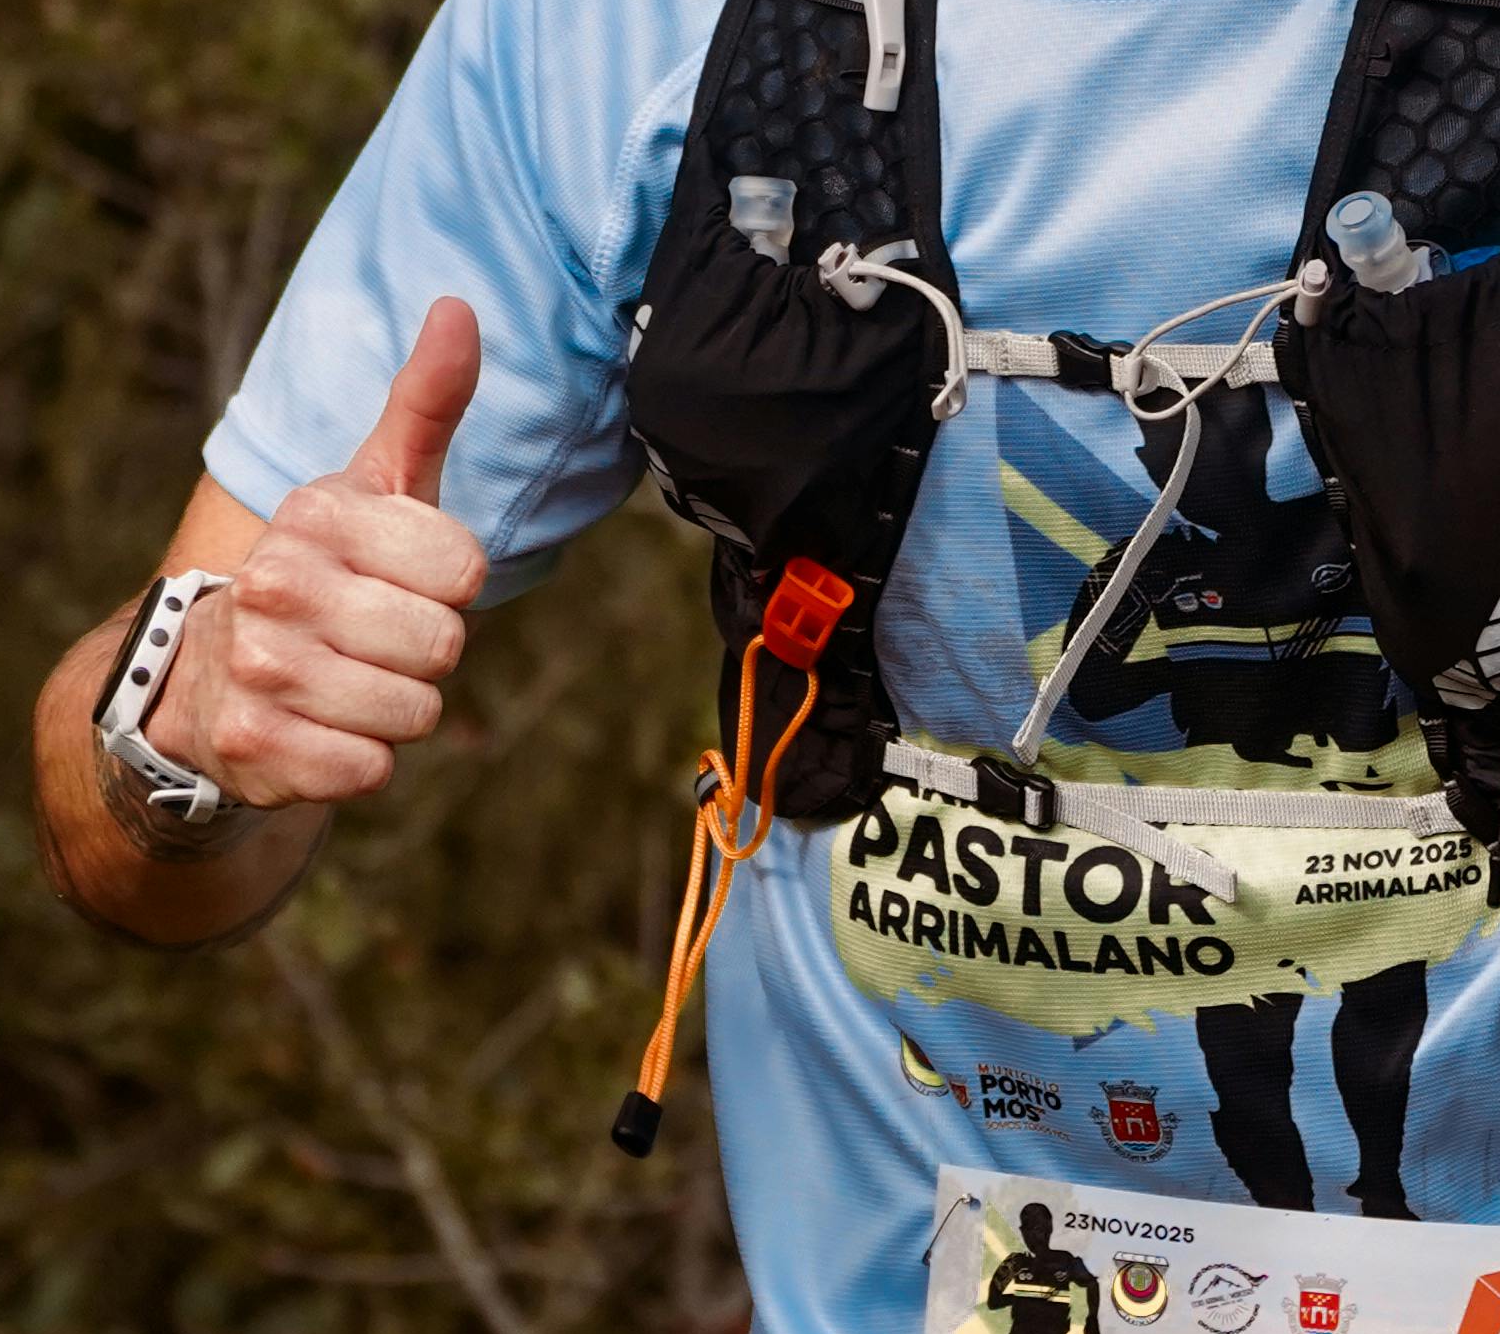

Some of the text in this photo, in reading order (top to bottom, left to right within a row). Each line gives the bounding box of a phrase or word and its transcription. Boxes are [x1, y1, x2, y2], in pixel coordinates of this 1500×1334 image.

[1305, 837, 1472, 874] 23 NOV 2025
[1295, 865, 1482, 905] ARRIMALANO
[849, 880, 1234, 976] ARRIMALANO
[980, 1074, 1062, 1111] PORTO
[1064, 1212, 1195, 1244] 23NOV2025
